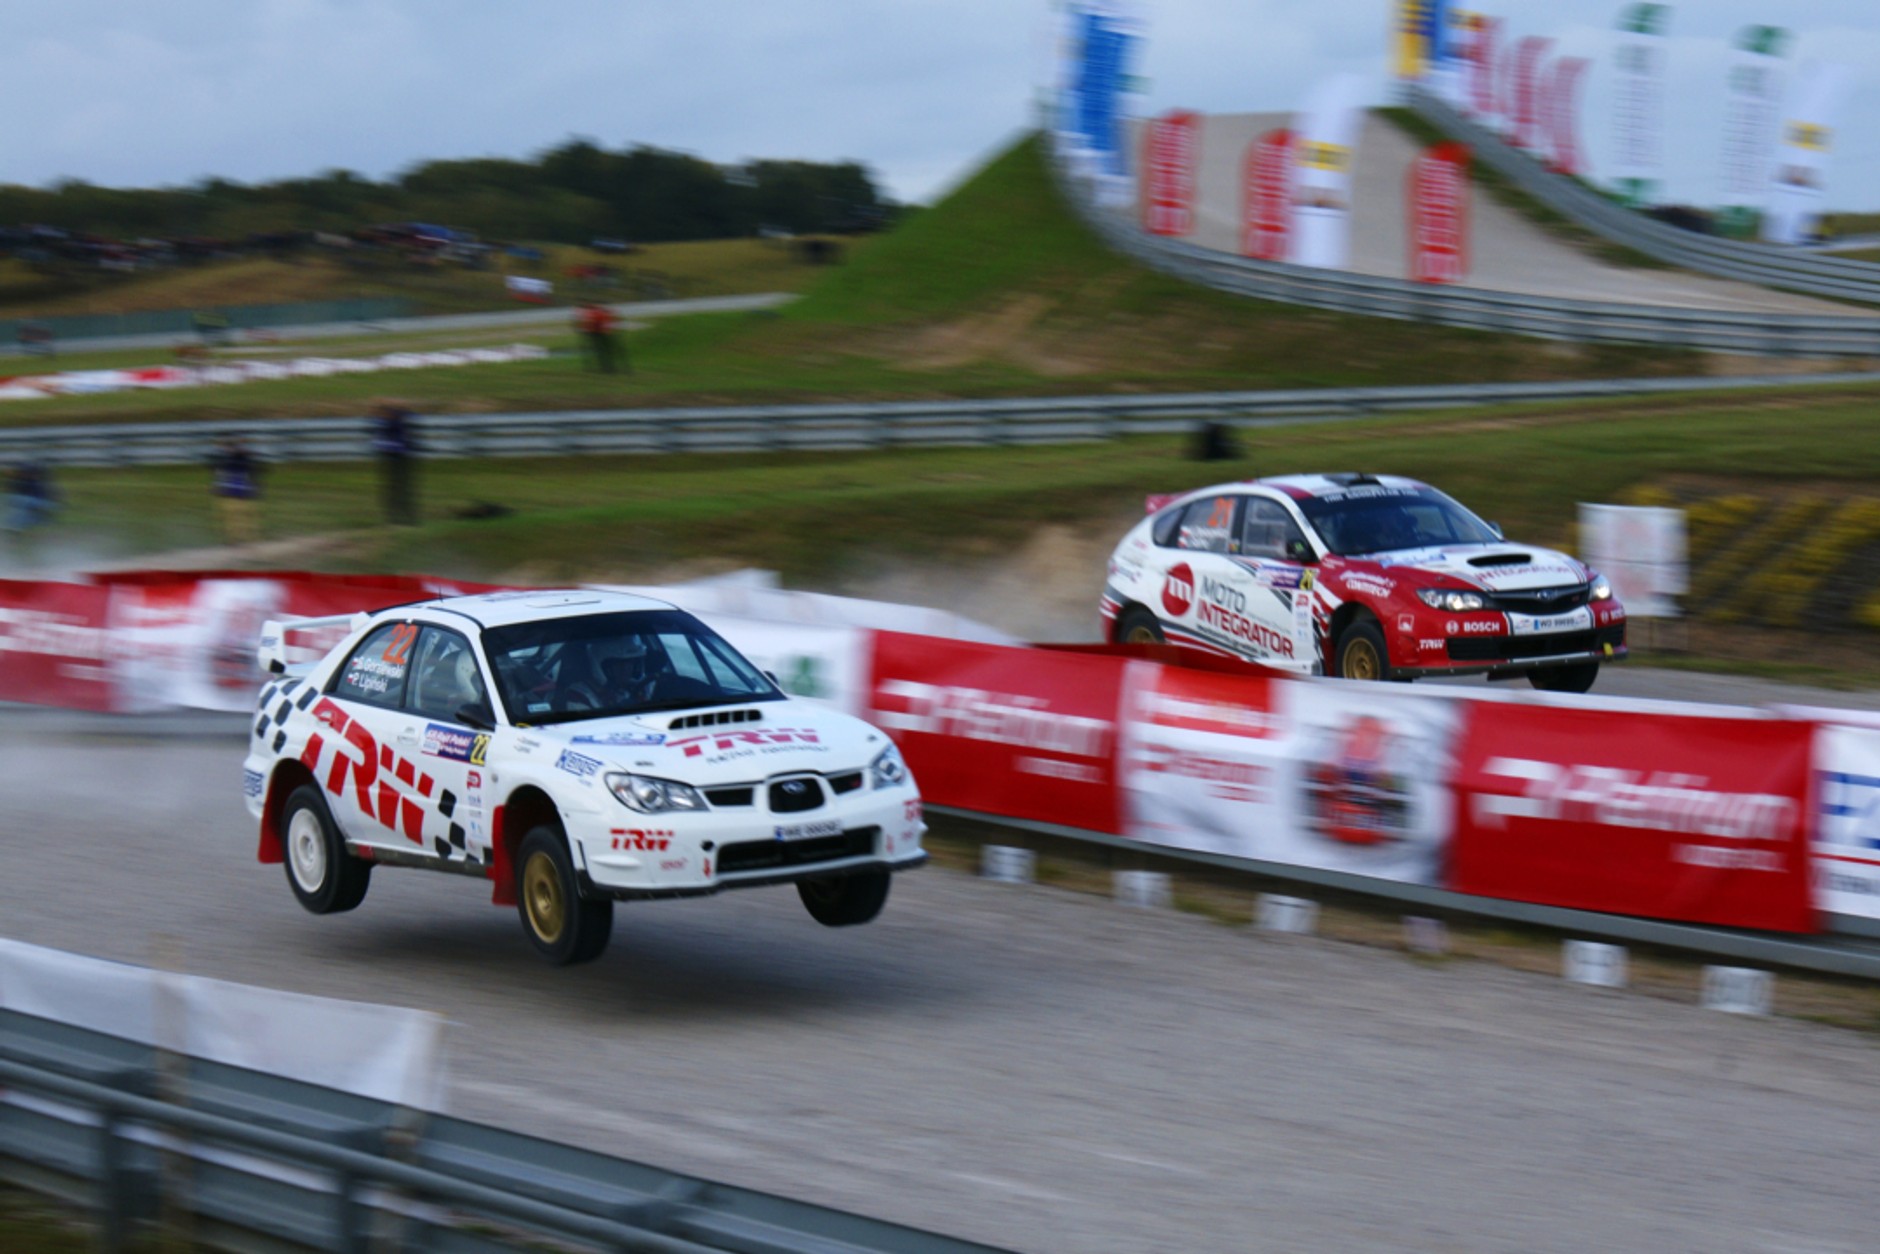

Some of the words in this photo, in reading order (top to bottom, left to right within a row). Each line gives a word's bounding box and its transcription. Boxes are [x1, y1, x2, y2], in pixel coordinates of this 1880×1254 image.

[1201, 575, 1246, 613] MOTO
[1196, 598, 1295, 660] INTEGRATOR
[1463, 621, 1500, 633] BOSCH
[382, 623, 418, 666] 22
[1419, 638, 1445, 651] TRW
[470, 733, 492, 767] 22
[665, 728, 820, 758] TRW
[300, 697, 435, 846] TRW
[610, 828, 674, 851] TRW
